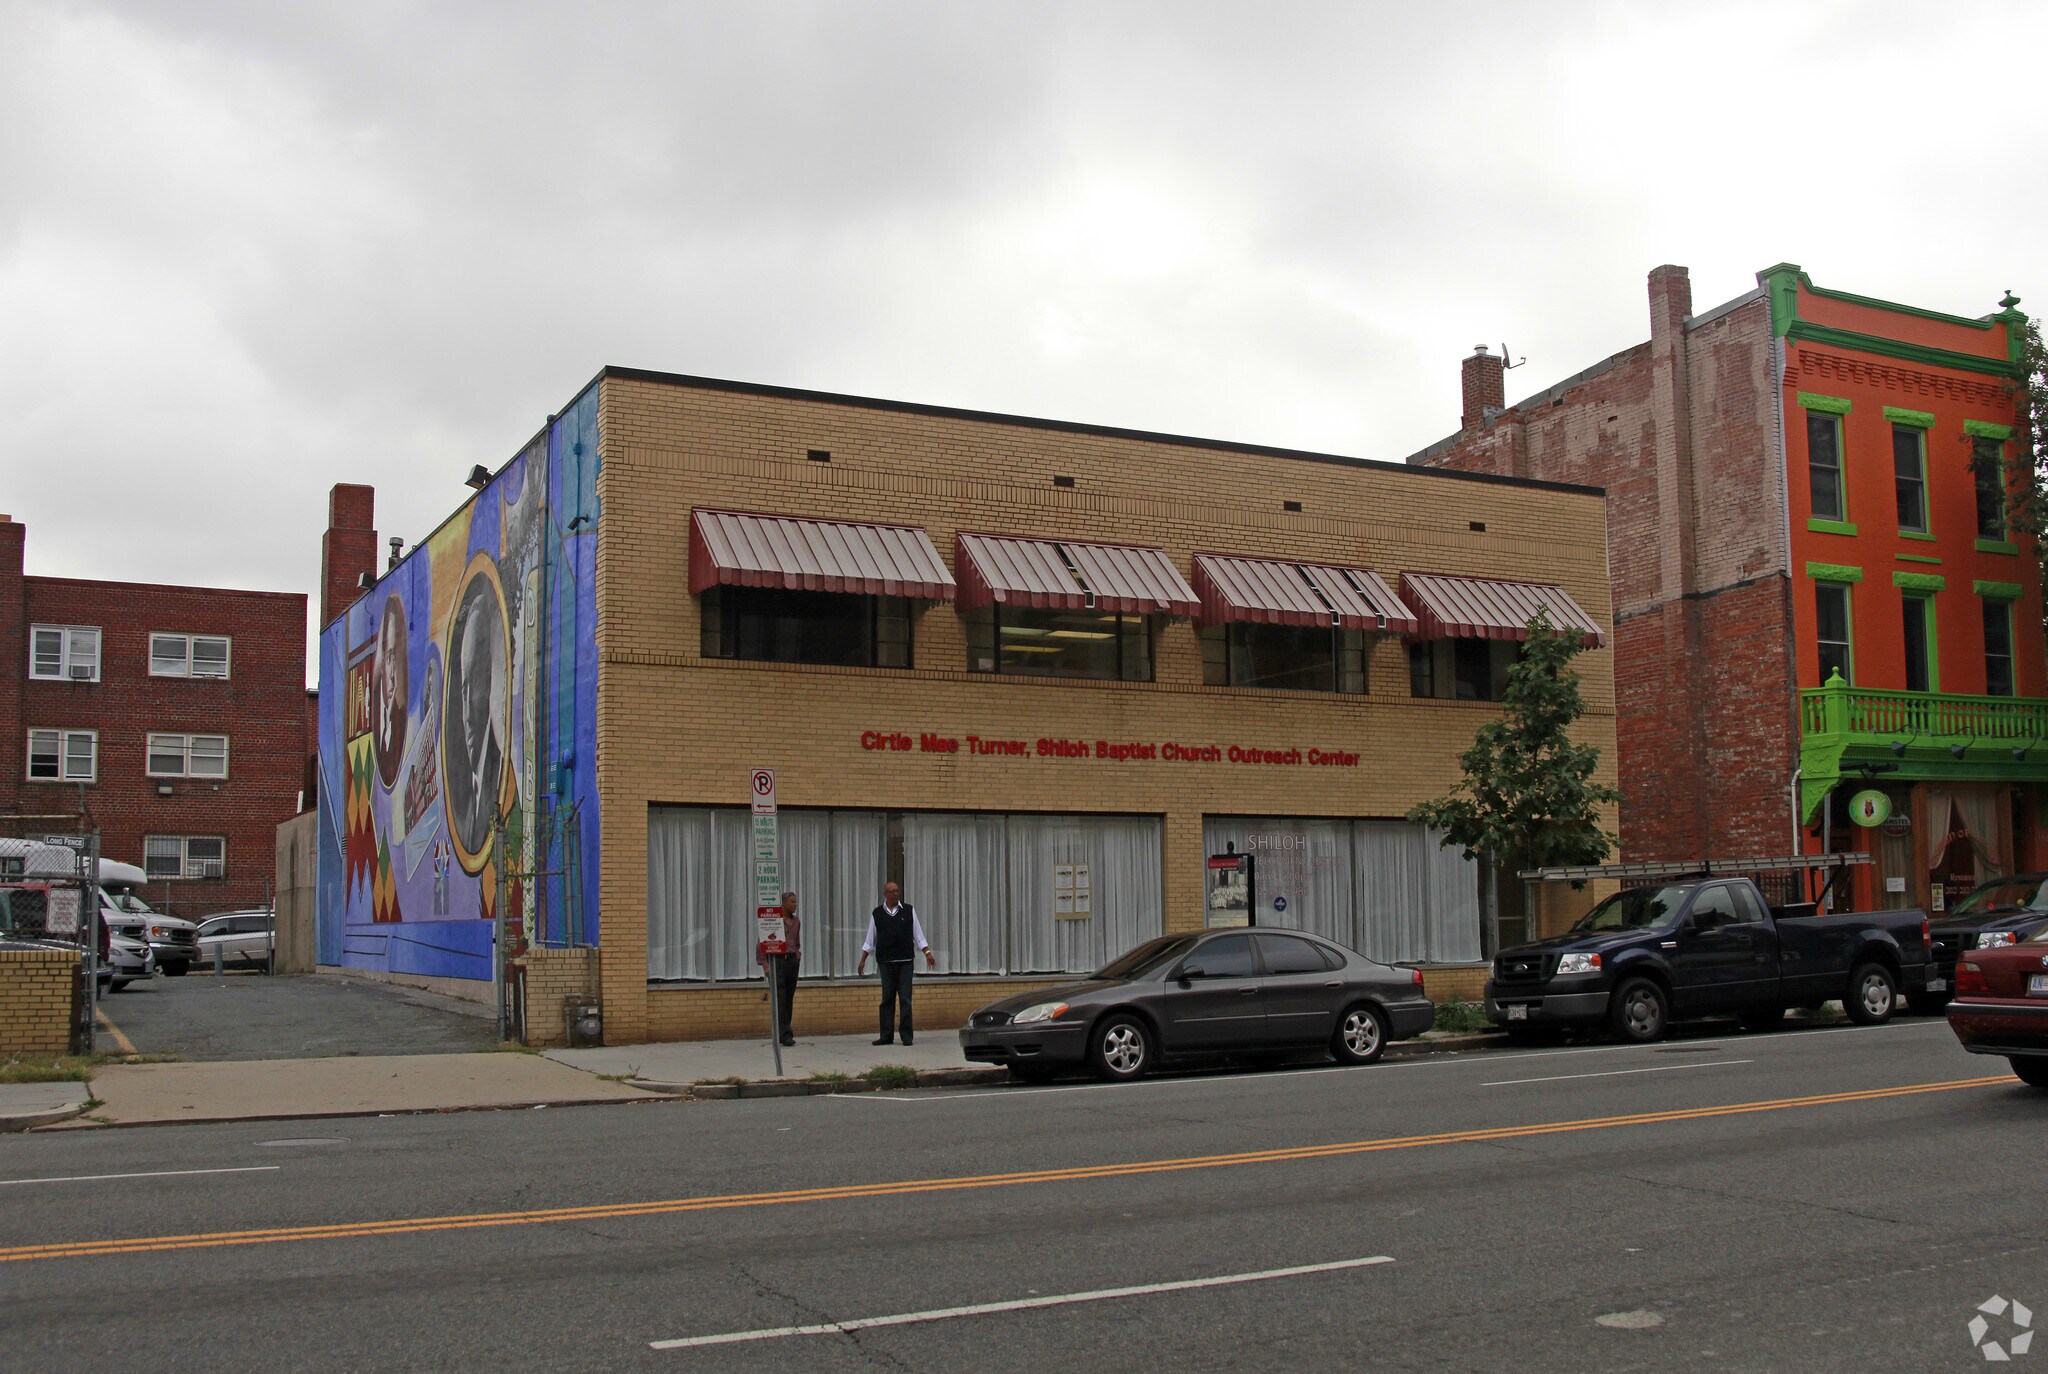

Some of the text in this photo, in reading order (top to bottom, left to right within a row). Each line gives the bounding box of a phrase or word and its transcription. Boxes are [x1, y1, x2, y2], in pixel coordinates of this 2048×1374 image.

[861, 731, 1360, 767] Cirtie Mae Turner, Shiloh Baptist Church Outreach Center
[756, 828, 776, 836] PARKING
[46, 836, 83, 846] LONG FENCE
[1248, 834, 1306, 850] SHILOH
[1254, 856, 1307, 865] VELOPMENT
[758, 866, 777, 874] 2 HOUR
[757, 876, 779, 884] PARKING
